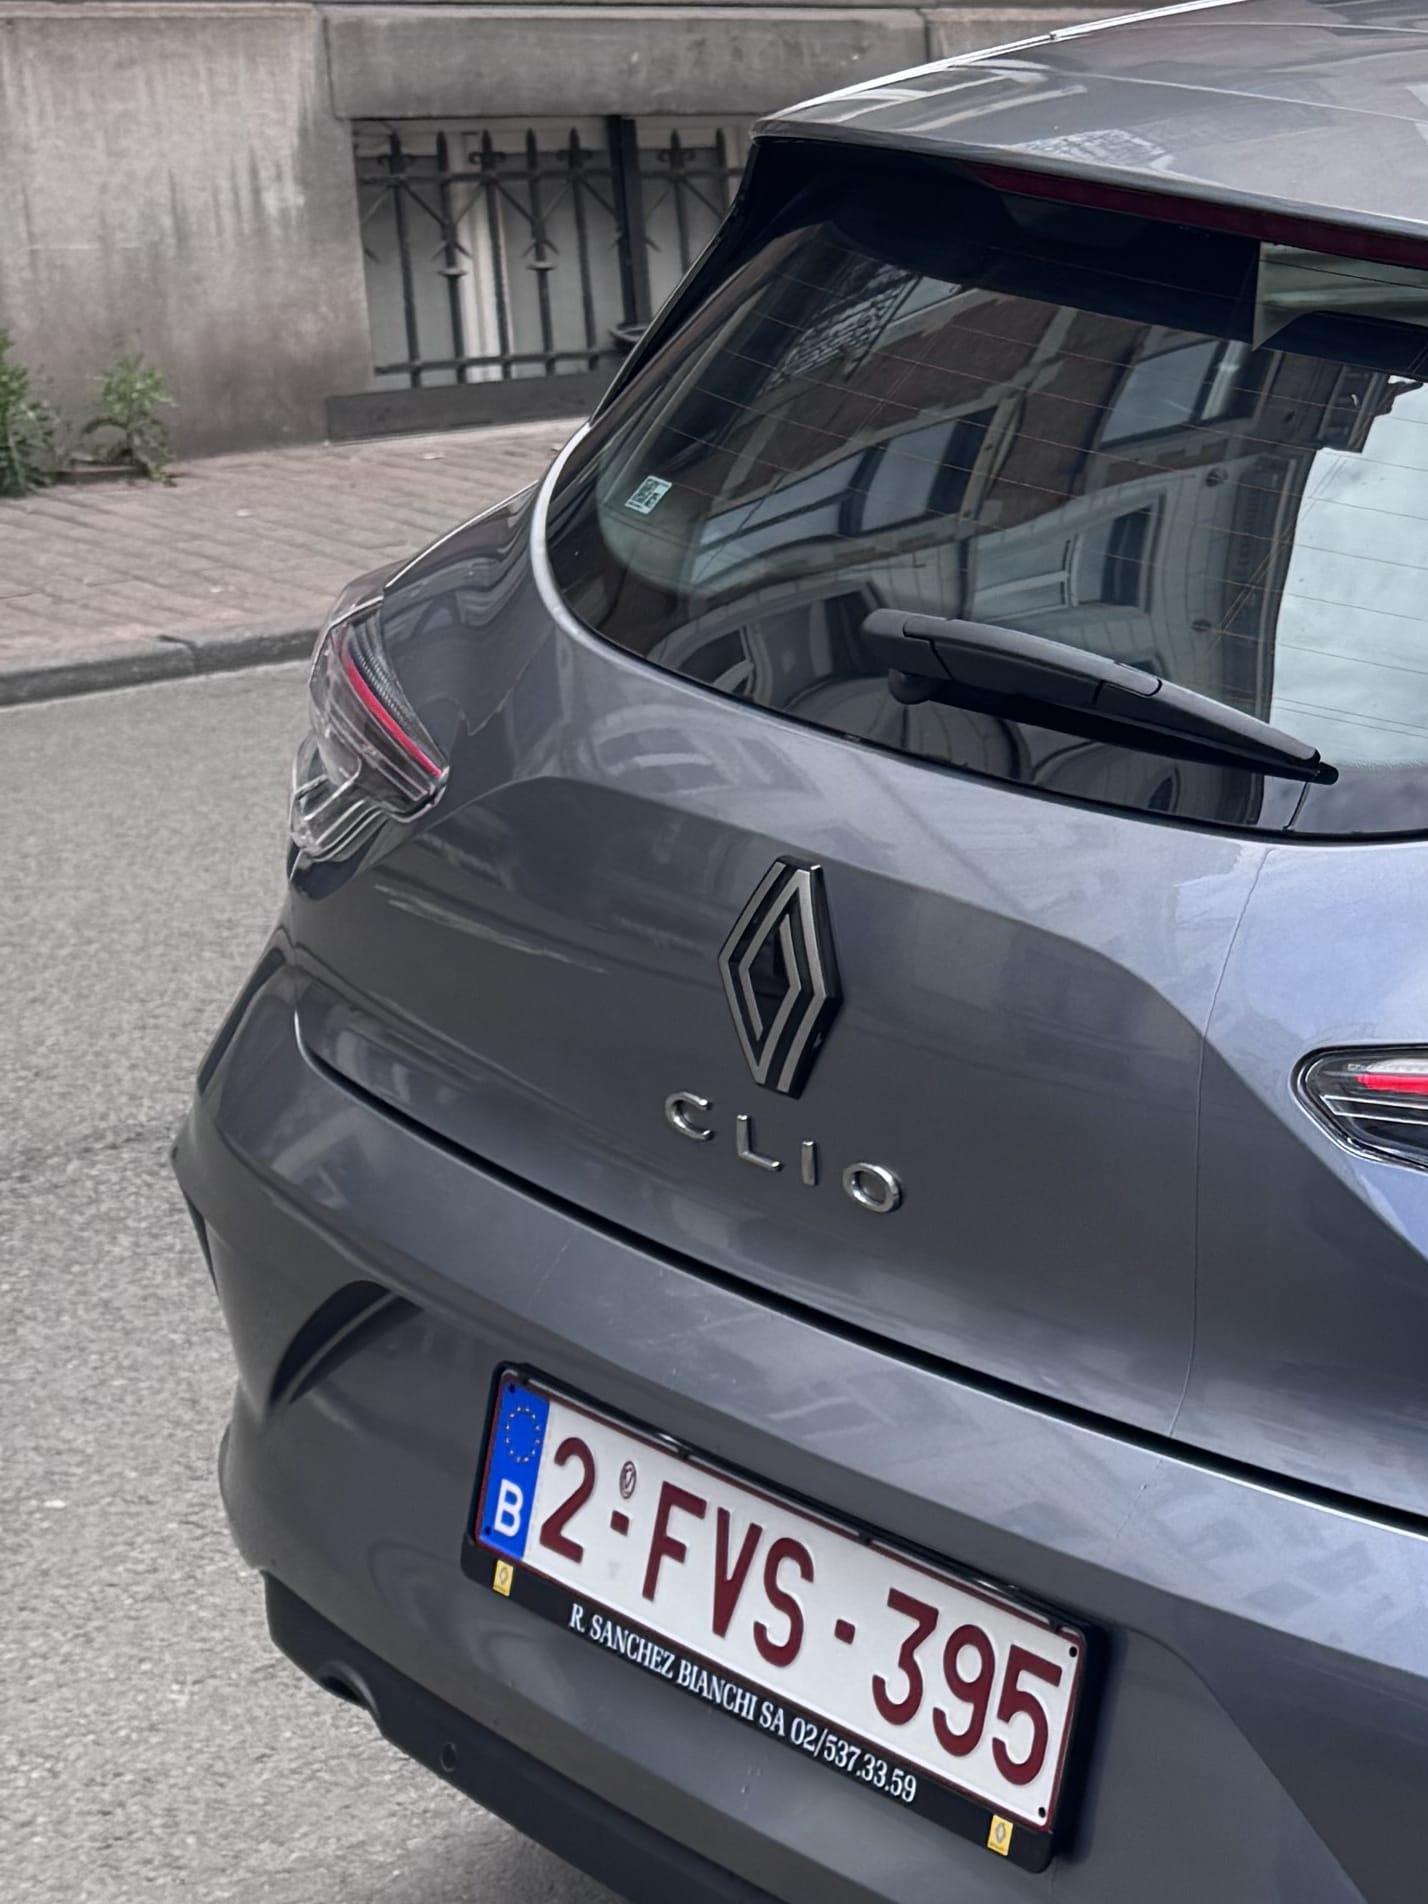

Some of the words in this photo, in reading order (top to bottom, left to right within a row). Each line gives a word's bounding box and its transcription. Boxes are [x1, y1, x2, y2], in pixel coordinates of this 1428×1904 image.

[664, 1091, 904, 1214] CLIO
[493, 1478, 525, 1538] B
[539, 1436, 1063, 1787] 2-FVS-395
[568, 1603, 586, 1634] R.
[590, 1612, 676, 1680] SANCHEZ
[676, 1659, 757, 1722] BIANCHI
[759, 1703, 785, 1737] SA
[790, 1717, 917, 1804] 02/537.33.59
